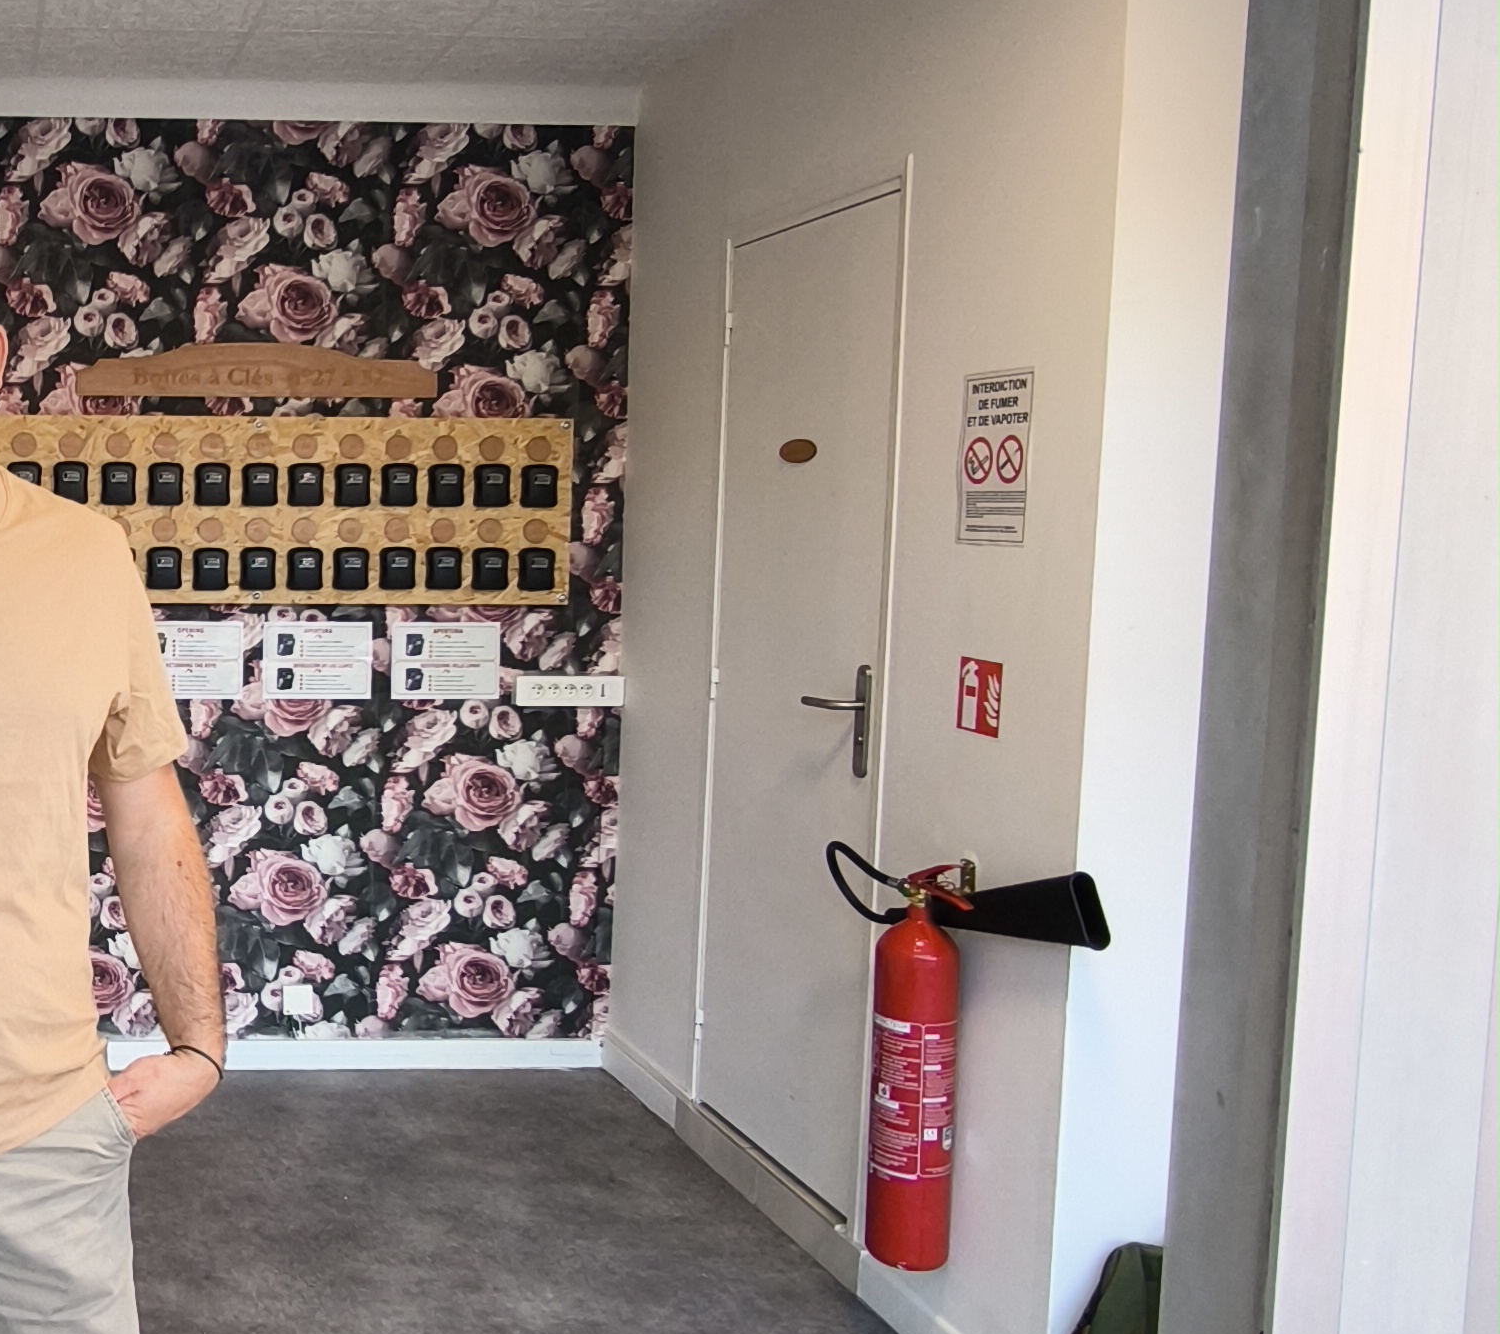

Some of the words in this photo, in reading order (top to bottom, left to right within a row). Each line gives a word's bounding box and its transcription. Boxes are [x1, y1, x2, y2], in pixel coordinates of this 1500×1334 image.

[227, 366, 273, 386] Clés
[972, 378, 1028, 394] INTERDICTION
[978, 399, 989, 410] DE
[991, 396, 1019, 410] FUMER
[967, 416, 977, 427] ET
[978, 415, 989, 427] DE
[991, 412, 1029, 426] VAPOTER
